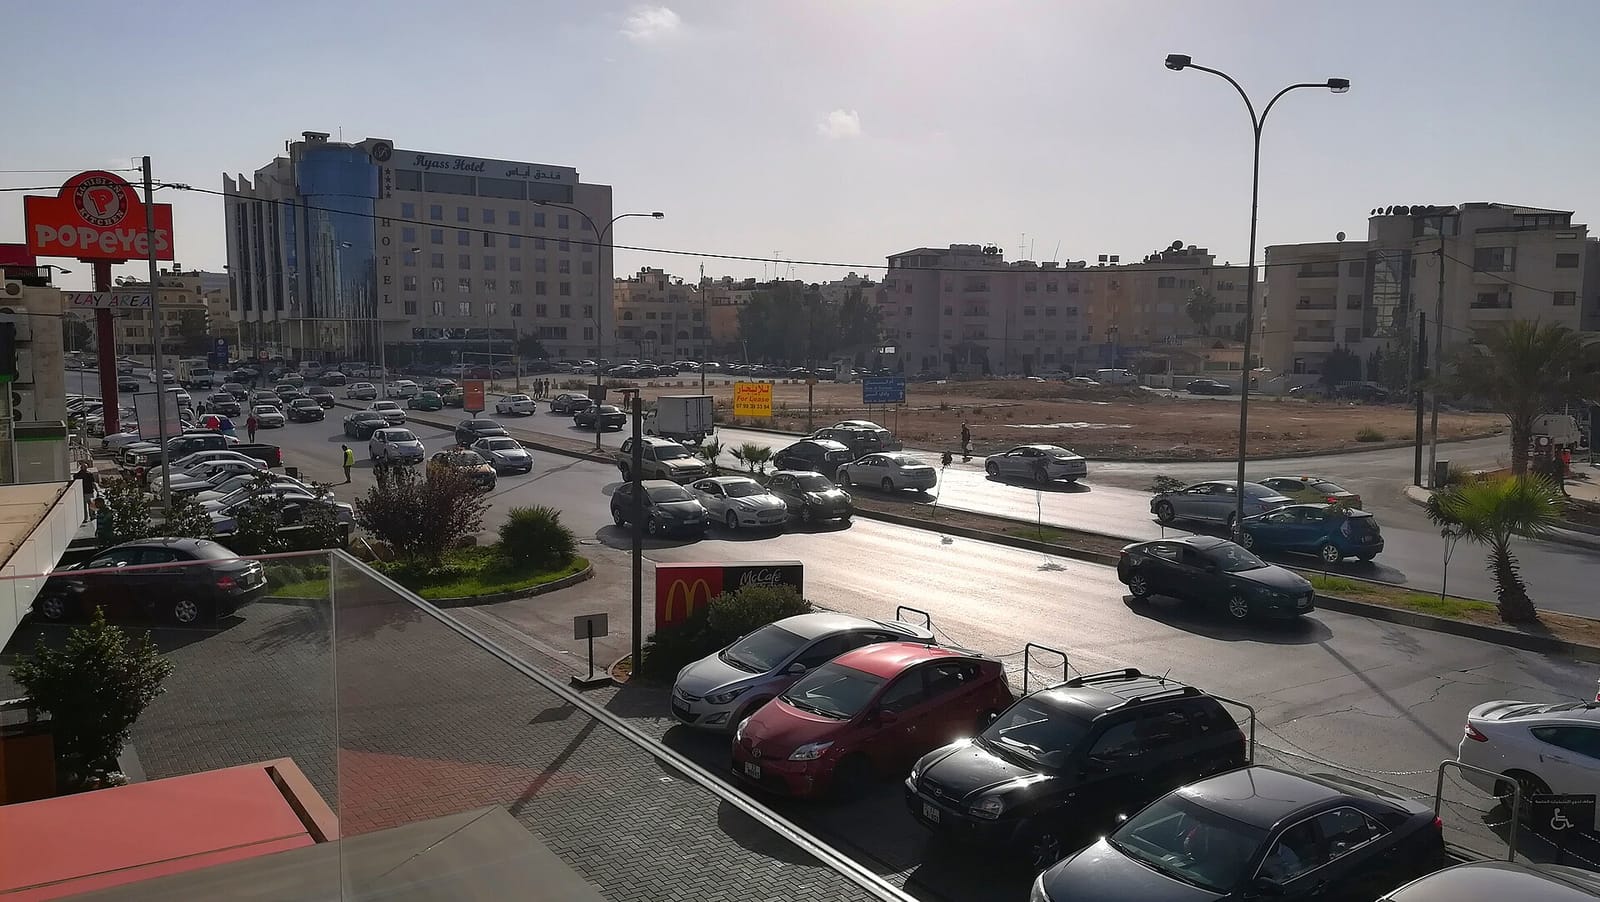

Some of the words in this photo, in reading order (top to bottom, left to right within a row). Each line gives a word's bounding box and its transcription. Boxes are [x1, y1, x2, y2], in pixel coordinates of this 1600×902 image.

[413, 155, 450, 170] Ayass
[453, 159, 485, 172] Hotel
[381, 217, 393, 304] HOTEL
[108, 295, 151, 308] AREA
